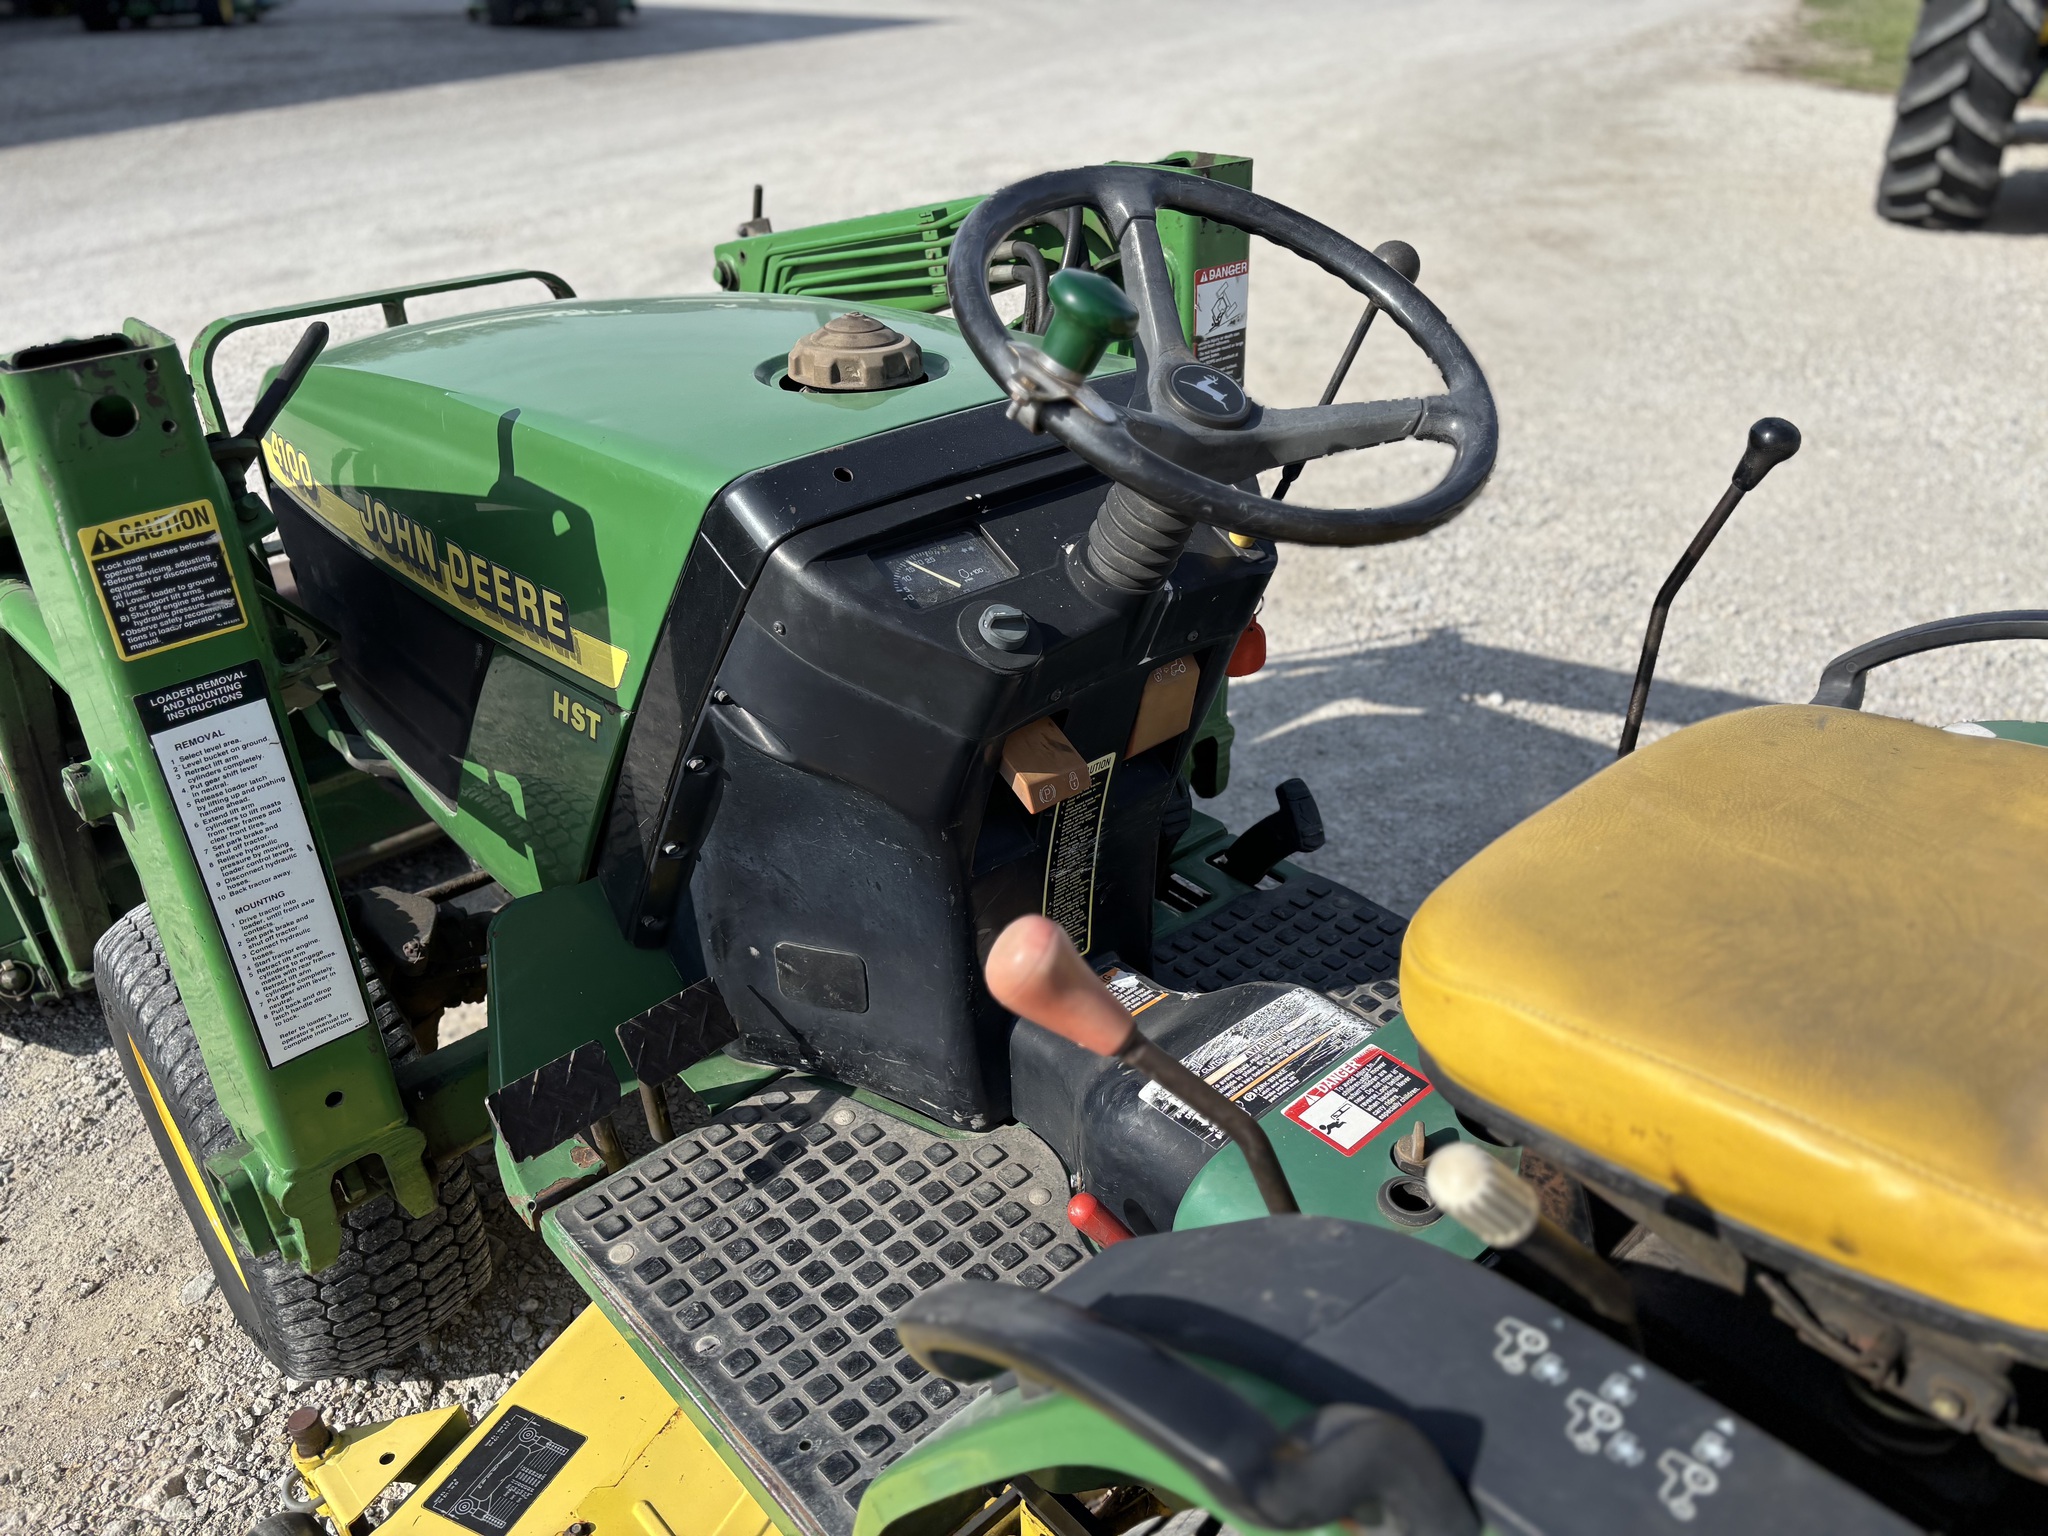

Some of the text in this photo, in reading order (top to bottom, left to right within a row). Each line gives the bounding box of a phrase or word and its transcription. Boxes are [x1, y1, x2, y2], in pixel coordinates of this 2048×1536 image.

[1209, 261, 1247, 281] DANGER
[271, 429, 315, 492] 4100
[119, 506, 209, 545] CAUTION
[101, 541, 205, 571] Lock loader latches before
[358, 492, 571, 646] JOHN DEERE
[104, 565, 143, 579] operating
[107, 575, 134, 586] Before
[175, 555, 211, 568] adjusting
[110, 577, 151, 593] equipment
[163, 561, 217, 579] disconnecting
[112, 593, 123, 601] oil
[125, 594, 150, 605] Lower
[151, 587, 176, 598] loader
[187, 576, 215, 590] ground
[130, 609, 149, 619] Shut
[150, 605, 161, 614] off
[163, 599, 189, 610] engine
[191, 594, 205, 603] and
[206, 588, 231, 598] relieve
[139, 596, 169, 609] support
[125, 623, 158, 636] Observe
[159, 616, 182, 627] safety
[127, 634, 148, 643] tions
[184, 613, 222, 627] operator's
[133, 612, 170, 626] hydraulic
[150, 671, 246, 706] LOADER REMOVAL
[163, 682, 241, 713] AND MOUNTING
[167, 691, 243, 721] INSTRUCTIONS
[553, 691, 602, 741] HST
[174, 730, 225, 751] REMOVAL
[179, 750, 203, 762] Select
[203, 743, 222, 754] level
[182, 758, 202, 770] Level
[203, 749, 229, 762] bucket
[184, 764, 212, 777] Retract
[212, 759, 223, 767] lift
[224, 755, 239, 763] arm
[1088, 756, 1112, 774] UTION
[187, 768, 221, 783] cylinders
[189, 782, 203, 790] Put
[204, 777, 220, 787] gear
[222, 769, 239, 779] shift
[239, 763, 257, 773] lever
[194, 791, 224, 804] Release
[224, 782, 247, 793] loader
[249, 776, 268, 785] latch
[207, 797, 229, 807] lifting
[241, 786, 255, 795] and
[256, 776, 286, 791] pushing
[199, 806, 224, 818] handle
[202, 812, 228, 825] Extend
[241, 803, 255, 811] arm
[205, 816, 239, 831] cylinders
[260, 801, 281, 811] masts
[207, 807, 282, 838] from rear frames and
[210, 834, 227, 844] clear
[229, 827, 247, 837] front
[212, 843, 225, 851] Set
[226, 837, 242, 847] park
[243, 829, 264, 840] brake
[265, 823, 278, 832] and
[215, 848, 231, 858] shut
[232, 843, 242, 851] off
[217, 852, 243, 864] Relieve
[244, 839, 277, 854] hydraulic
[220, 856, 251, 872] pressure
[263, 841, 289, 854] moving
[222, 865, 244, 877] loader
[246, 854, 271, 868] control
[224, 865, 264, 884] Disconnect
[265, 853, 297, 868] hydraulic
[229, 887, 247, 897] Back
[248, 877, 271, 889] tractor
[235, 891, 285, 915] MOUNTING
[1201, 1056, 1227, 1075] CLUTCH
[1320, 1060, 1361, 1093] DANGER
